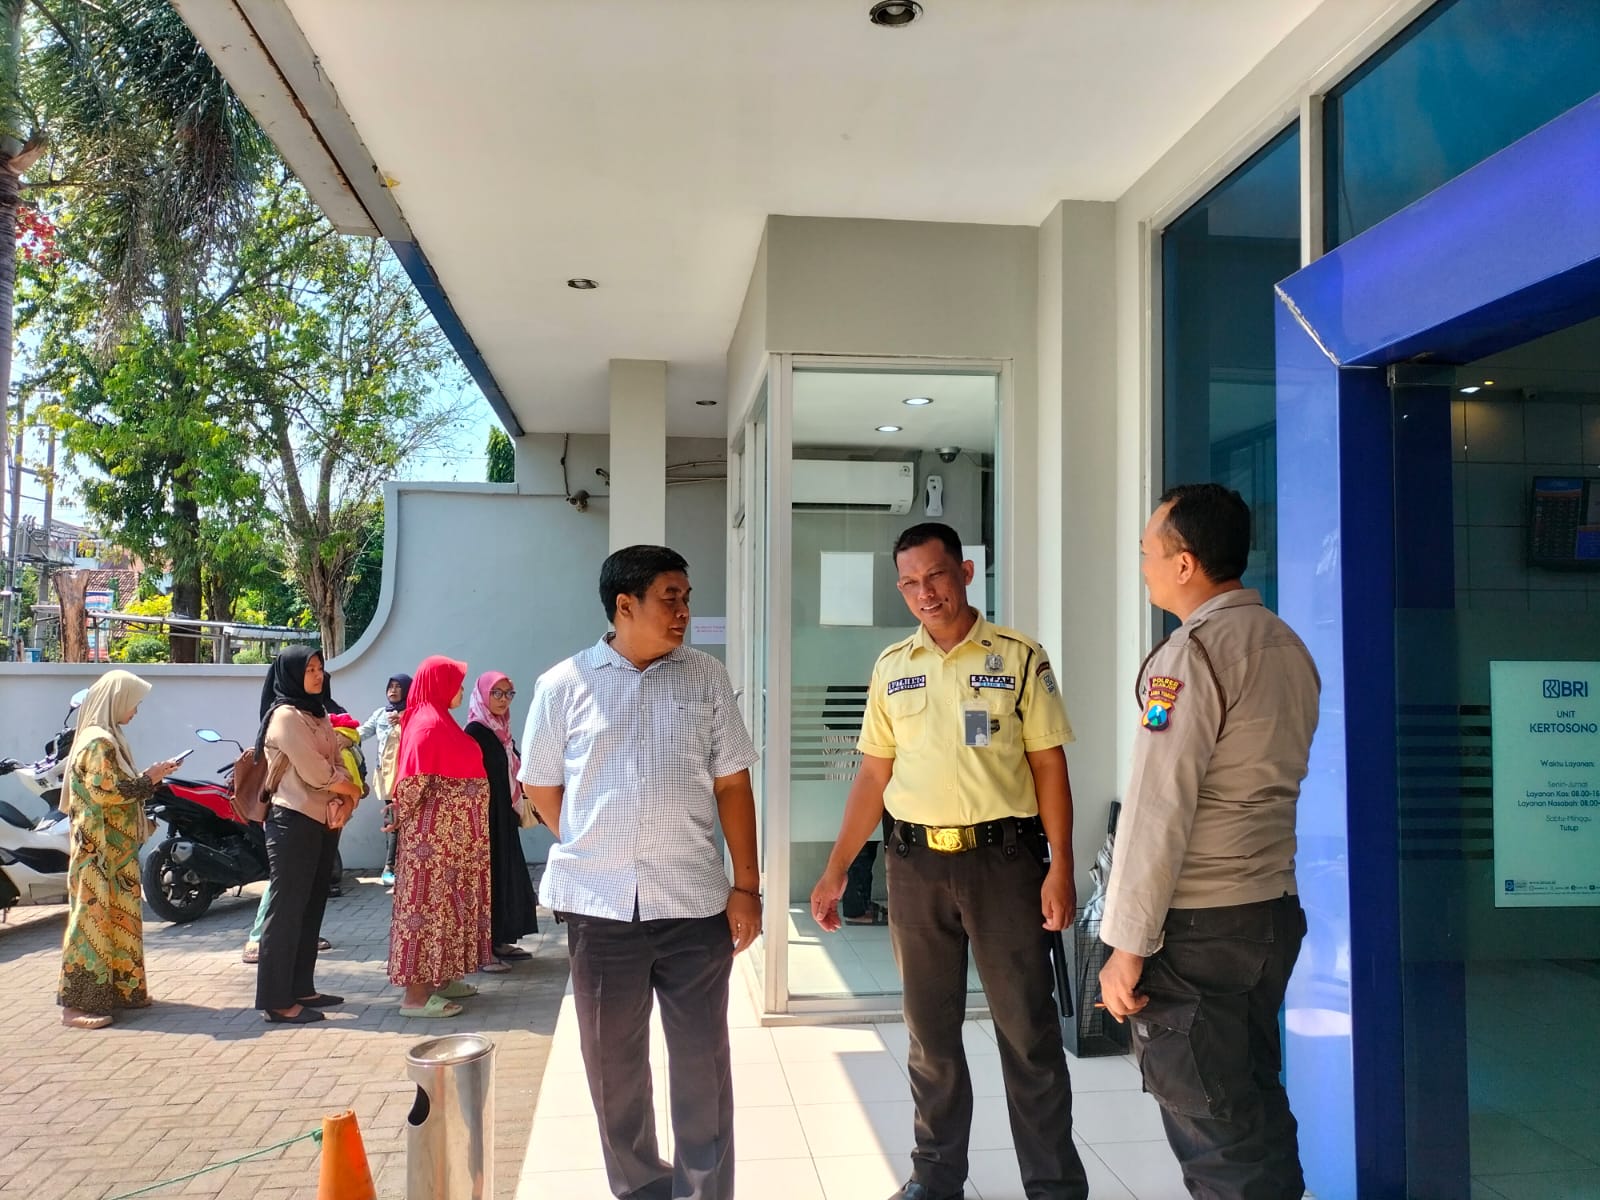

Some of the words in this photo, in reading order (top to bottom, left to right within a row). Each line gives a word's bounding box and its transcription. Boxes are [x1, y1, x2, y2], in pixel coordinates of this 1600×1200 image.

[1561, 681, 1589, 698] BRI
[1556, 710, 1576, 719] UNIT
[1529, 723, 1598, 734] KERTOSONO
[1540, 759, 1564, 768] Waktu
[1526, 790, 1555, 799] Layanan
[1518, 799, 1547, 809] Layanan
[1560, 824, 1580, 833] Tutup
